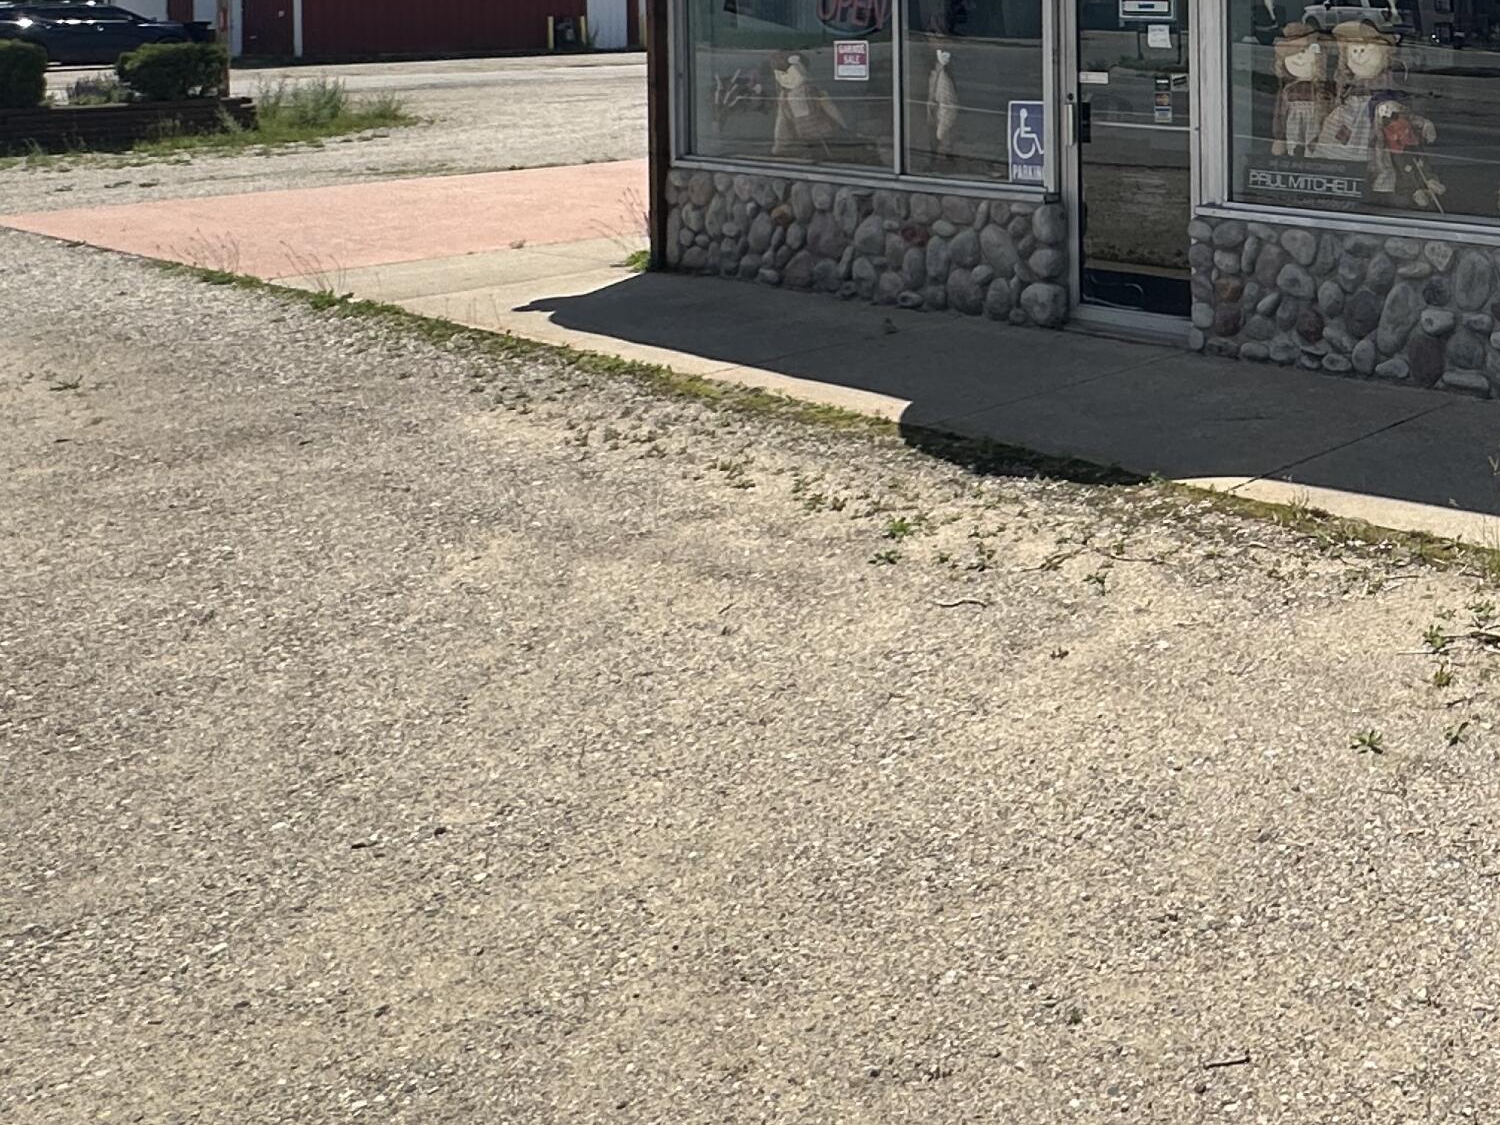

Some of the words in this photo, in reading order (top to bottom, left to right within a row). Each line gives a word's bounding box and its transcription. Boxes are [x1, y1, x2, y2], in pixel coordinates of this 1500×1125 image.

[843, 55, 860, 65] SALE
[1248, 171, 1288, 188] PAUL
[1288, 175, 1362, 195] MITCHELL
